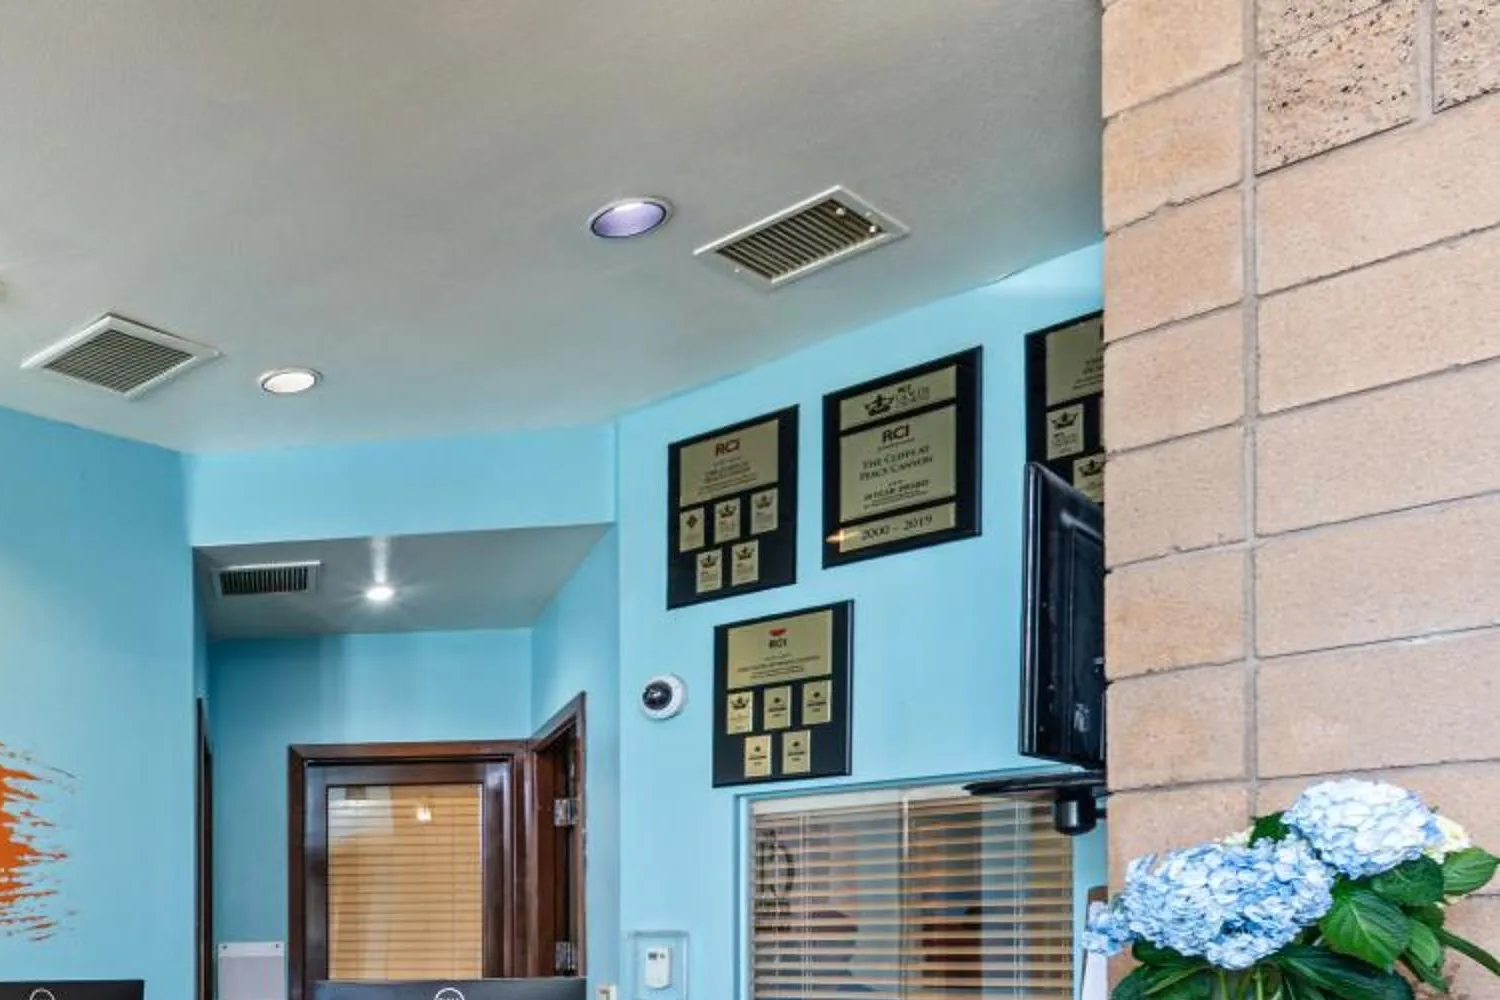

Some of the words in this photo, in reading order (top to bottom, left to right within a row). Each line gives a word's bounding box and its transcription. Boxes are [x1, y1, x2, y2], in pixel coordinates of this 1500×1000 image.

[881, 424, 910, 443] RCI
[715, 437, 741, 457] RCI
[903, 514, 933, 531] 2019
